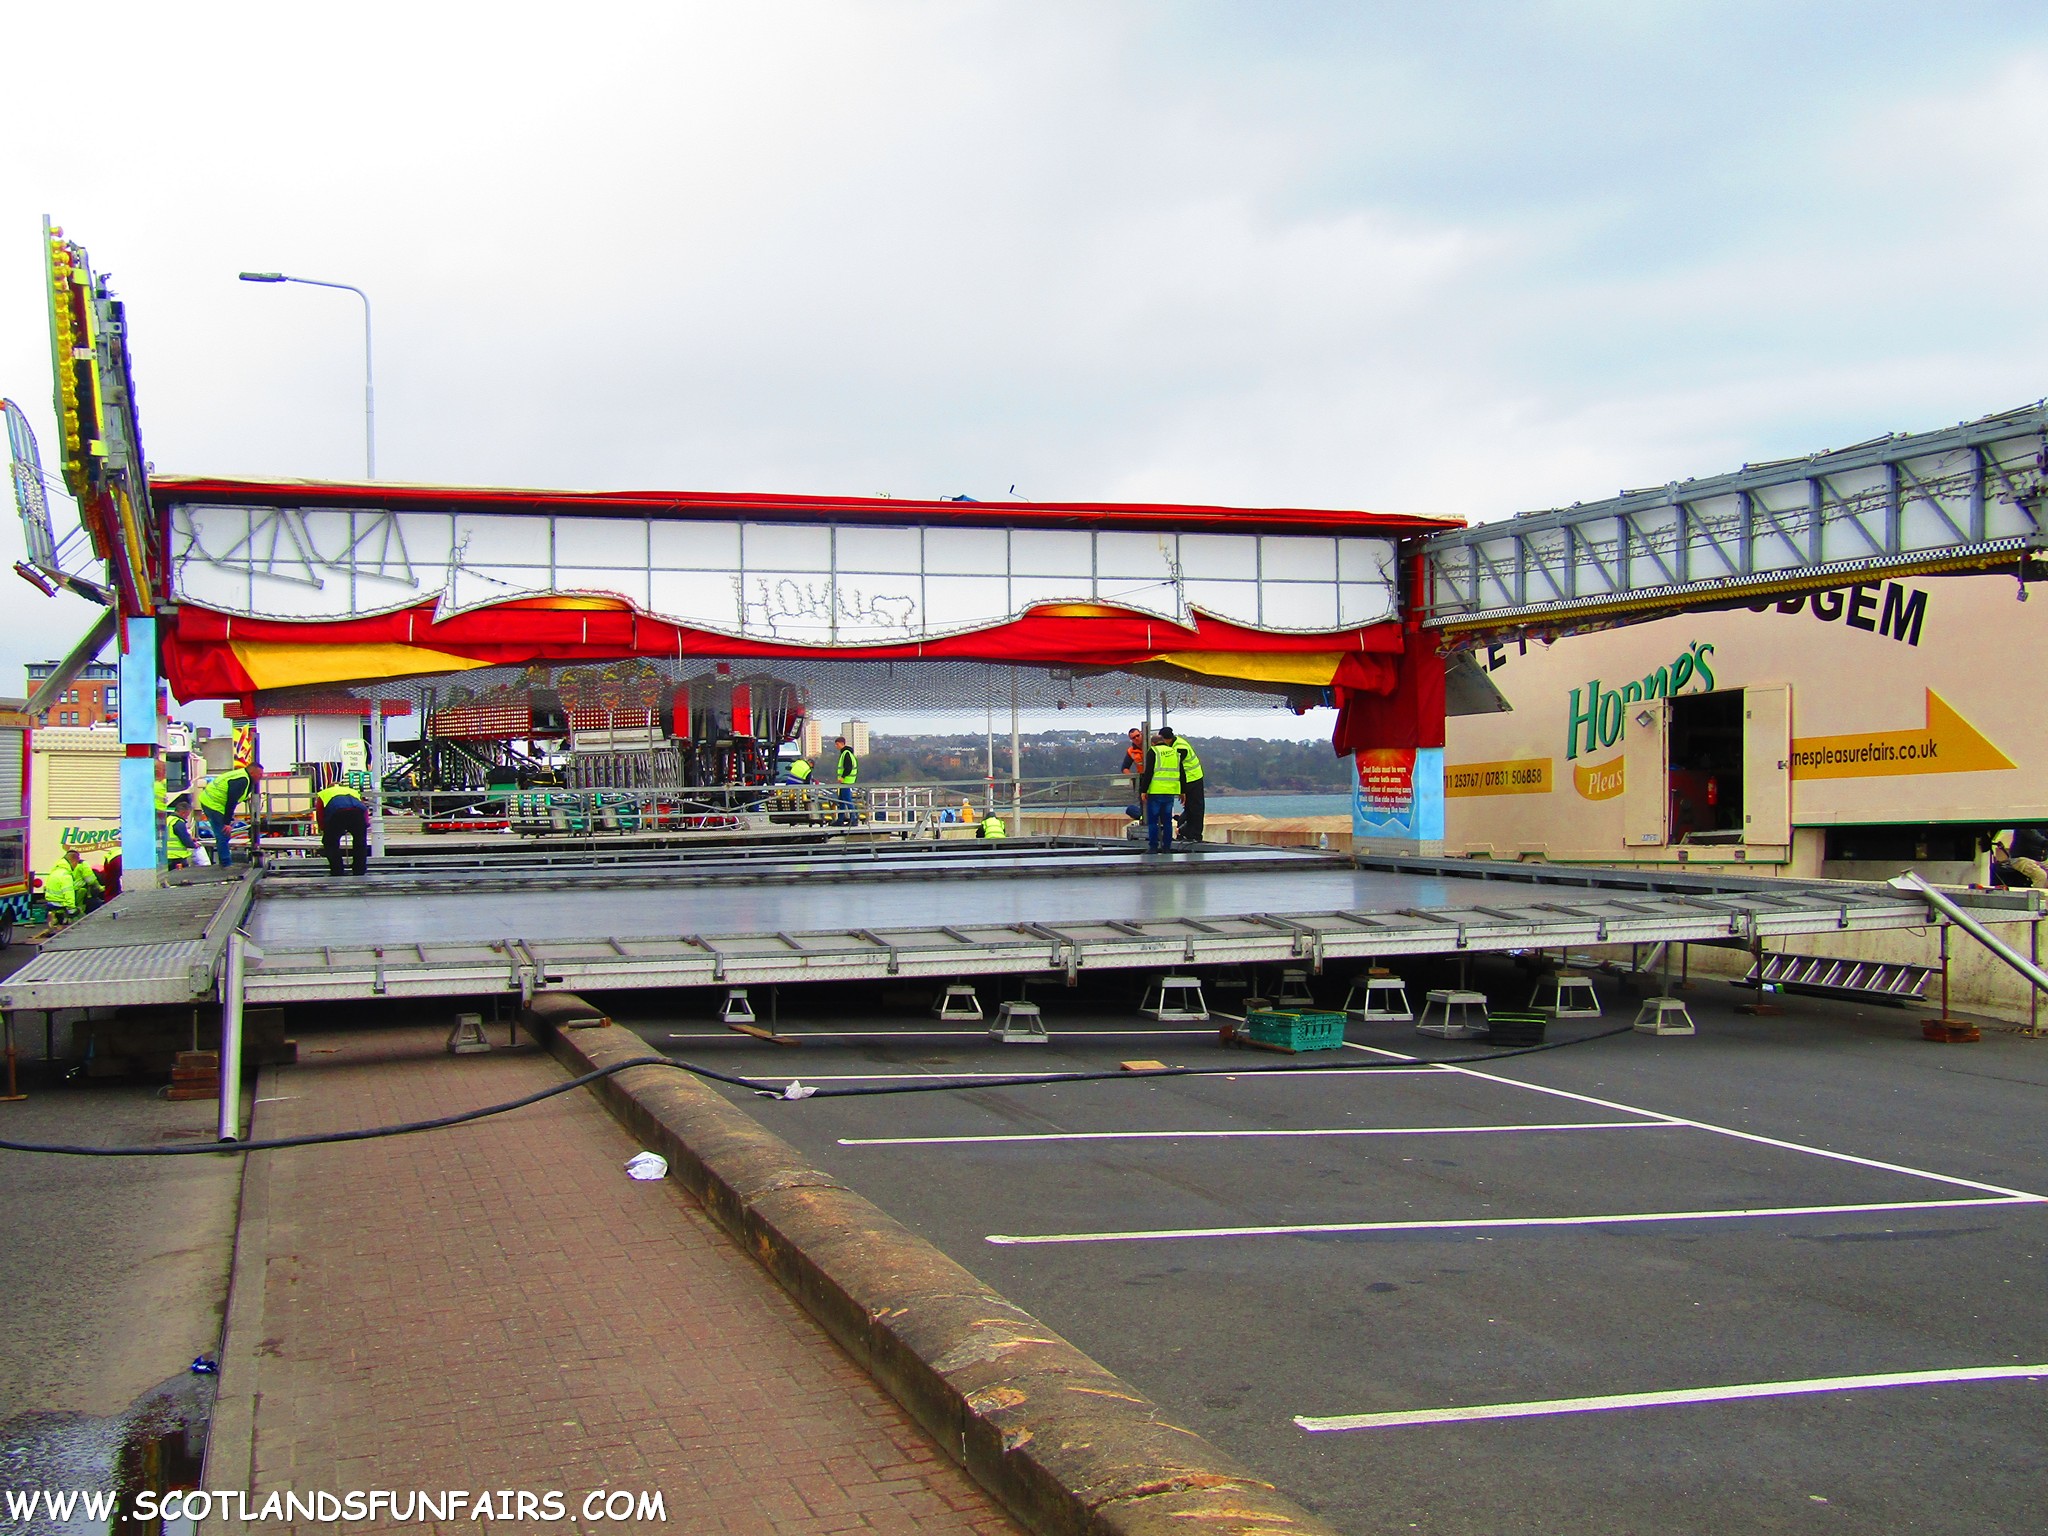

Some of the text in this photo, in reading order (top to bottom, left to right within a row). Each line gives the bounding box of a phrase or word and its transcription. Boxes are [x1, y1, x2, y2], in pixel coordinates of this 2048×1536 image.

[1455, 773, 1479, 788] 253767
[1486, 770, 1508, 786] 07831
[1512, 768, 1542, 784] 506858
